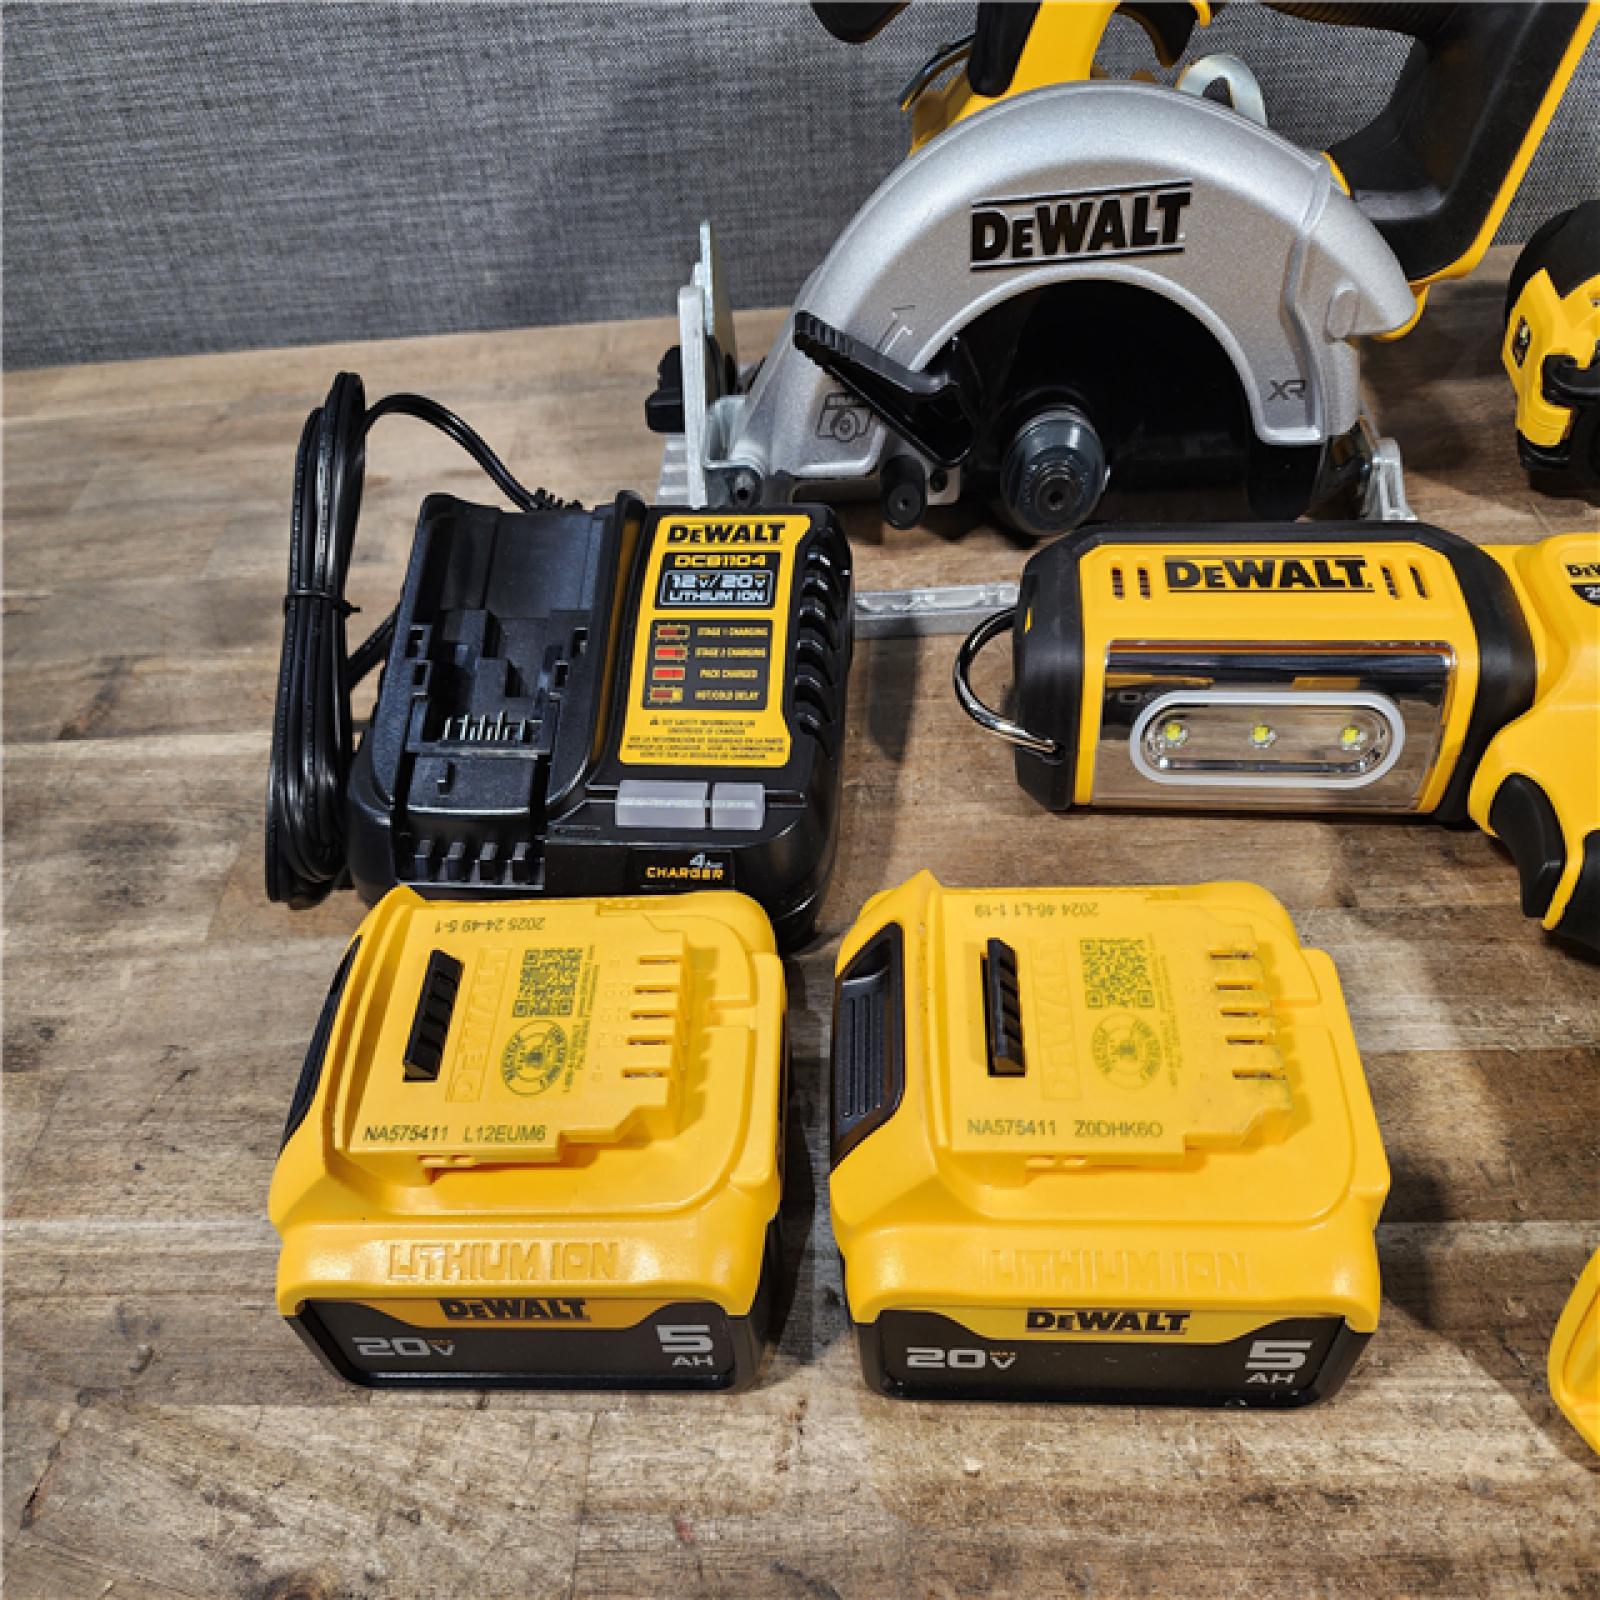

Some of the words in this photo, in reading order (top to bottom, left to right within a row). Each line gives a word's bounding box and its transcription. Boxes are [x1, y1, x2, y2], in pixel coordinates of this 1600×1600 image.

[970, 191, 1191, 263] DEWALT
[668, 523, 786, 543] DEWALT
[1165, 558, 1369, 590] DEWALT
[386, 1240, 542, 1281] LITHIUM
[550, 1241, 620, 1281] ION
[440, 1298, 591, 1321] DEWALT
[1026, 1310, 1191, 1334] DEWALT
[656, 1324, 713, 1354] 5
[1245, 1339, 1314, 1370] 5
